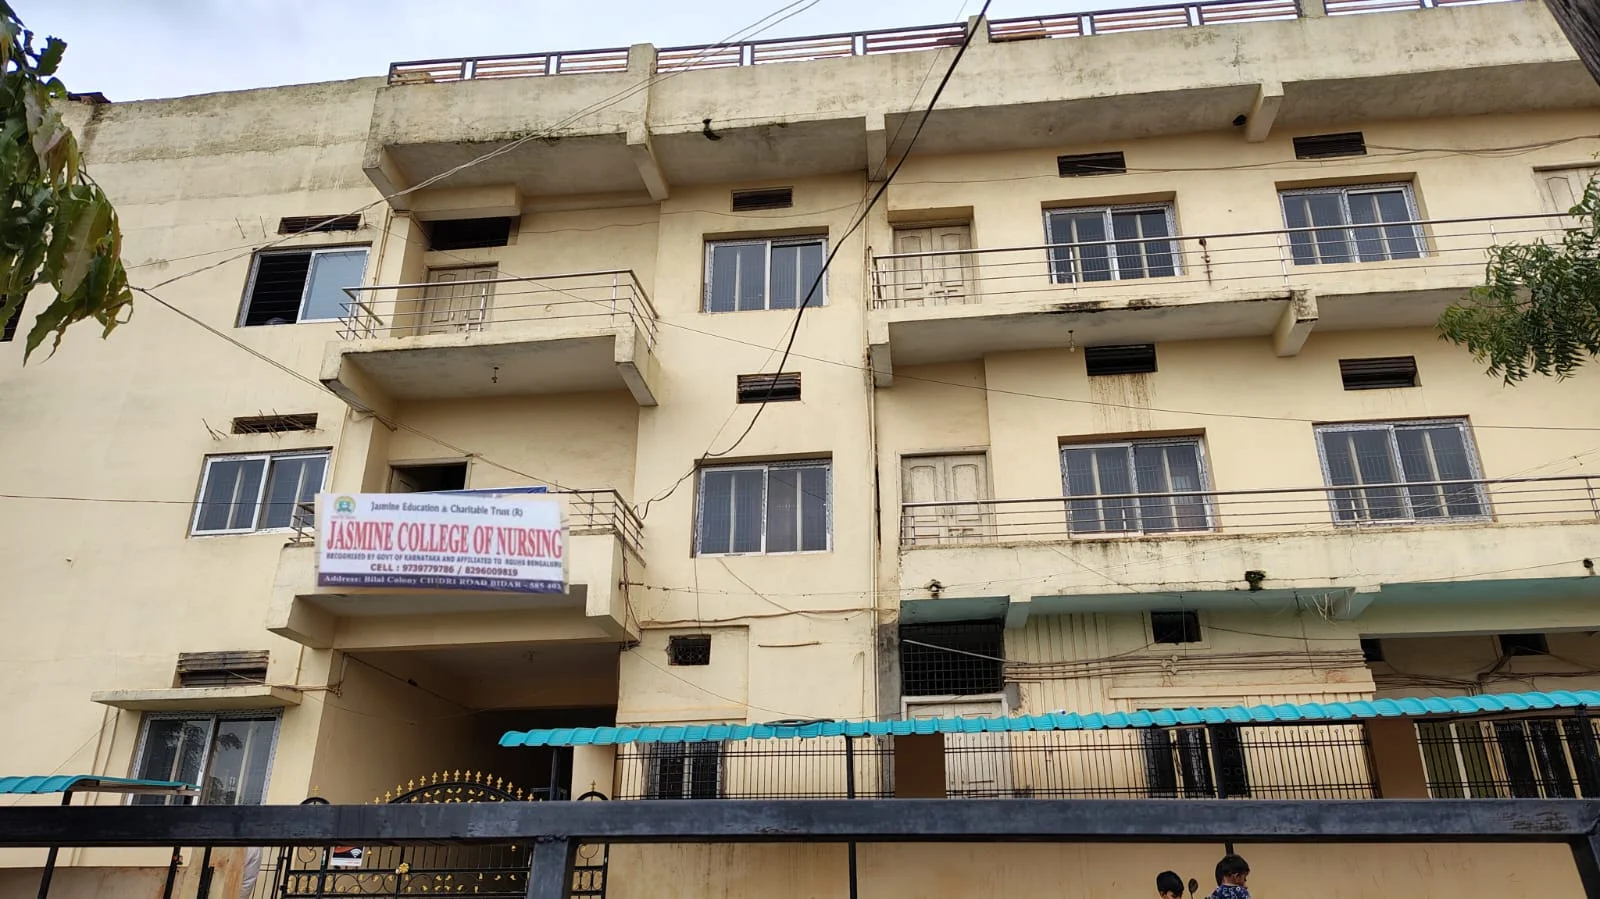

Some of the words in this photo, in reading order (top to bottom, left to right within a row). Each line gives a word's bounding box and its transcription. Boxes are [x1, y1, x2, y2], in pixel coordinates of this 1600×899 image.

[371, 502, 400, 512] Jasmine
[402, 502, 439, 512] Education
[450, 504, 488, 514] Charitable
[491, 506, 510, 516] Trust
[512, 508, 523, 517] (R)
[327, 520, 394, 550] JASMINE
[398, 522, 469, 553] COLLEGE
[473, 525, 494, 554] OF
[496, 527, 563, 559] NURSING
[326, 552, 366, 560] RECOGNISED
[456, 556, 492, 564] AFFILIATED
[527, 559, 562, 568] BENGALURU
[370, 564, 394, 572] CELL
[457, 566, 462, 574] /
[387, 576, 418, 584] Colony
